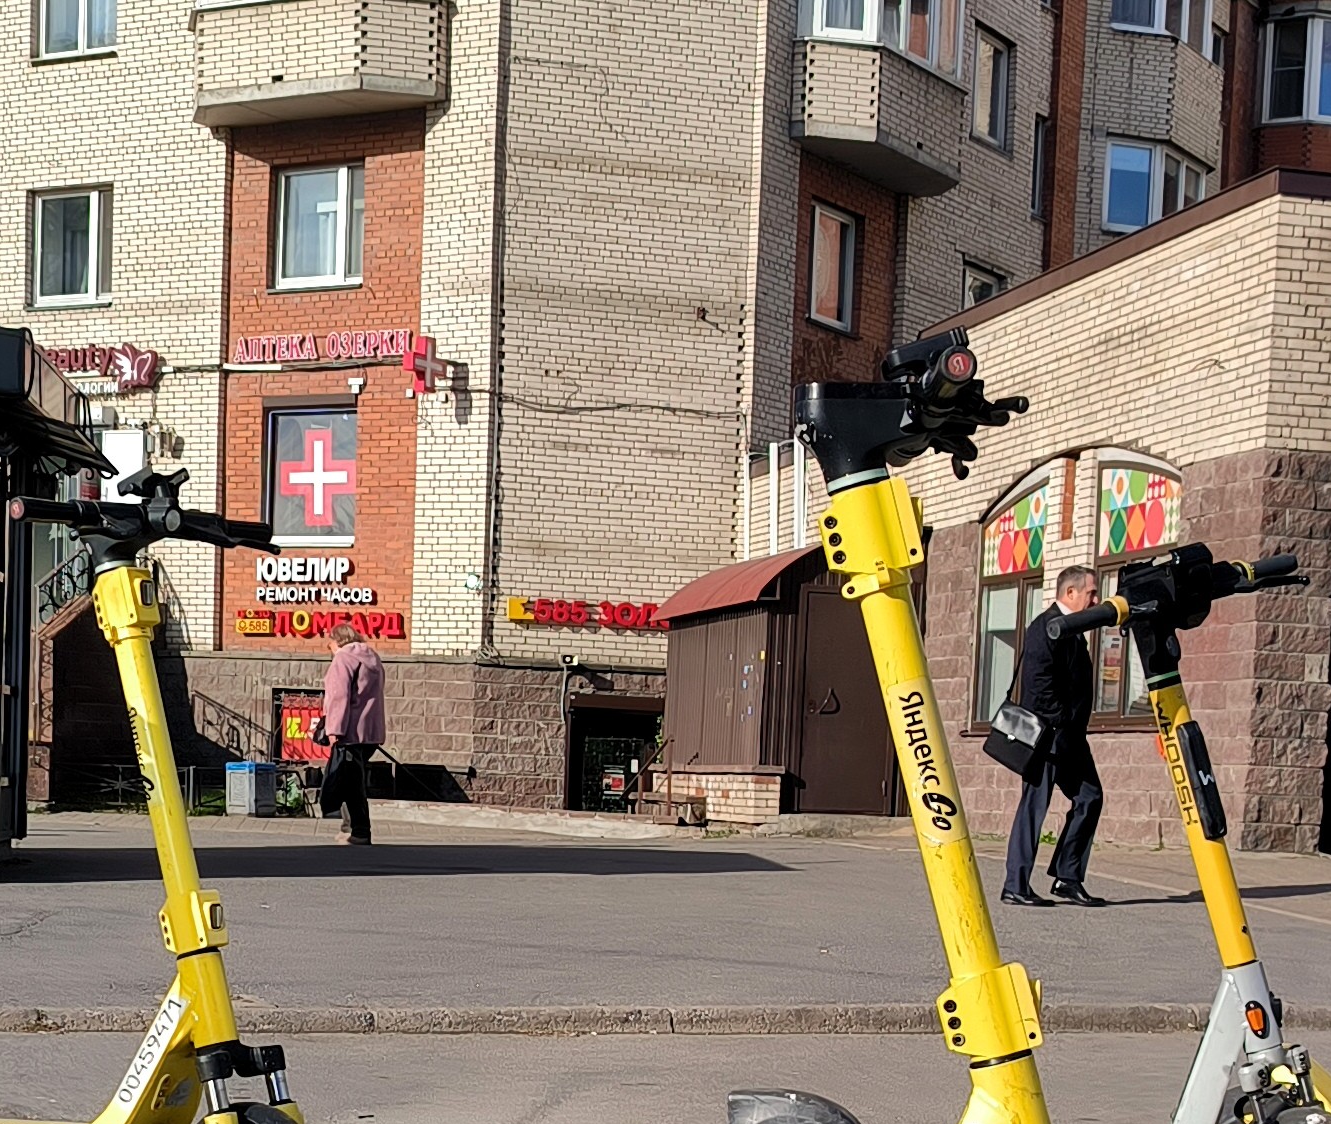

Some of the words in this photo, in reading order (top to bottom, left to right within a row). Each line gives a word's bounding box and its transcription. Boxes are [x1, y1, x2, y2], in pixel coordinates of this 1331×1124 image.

[36, 343, 114, 375] eauty
[234, 333, 318, 363] АПТЕКА
[325, 328, 411, 358] ОЗЕРКИ
[255, 556, 350, 582] ЮВЕЛИР
[255, 586, 319, 602] РЕМОНТ
[320, 587, 373, 603] ЧАСОВ
[248, 620, 268, 632] 585
[534, 598, 588, 624] 585
[598, 600, 670, 628] ЗОЛ
[898, 691, 941, 790] Яндекс
[921, 792, 958, 831] Go
[1155, 701, 1199, 826] WHOOSH
[118, 998, 182, 1103] 00459471
